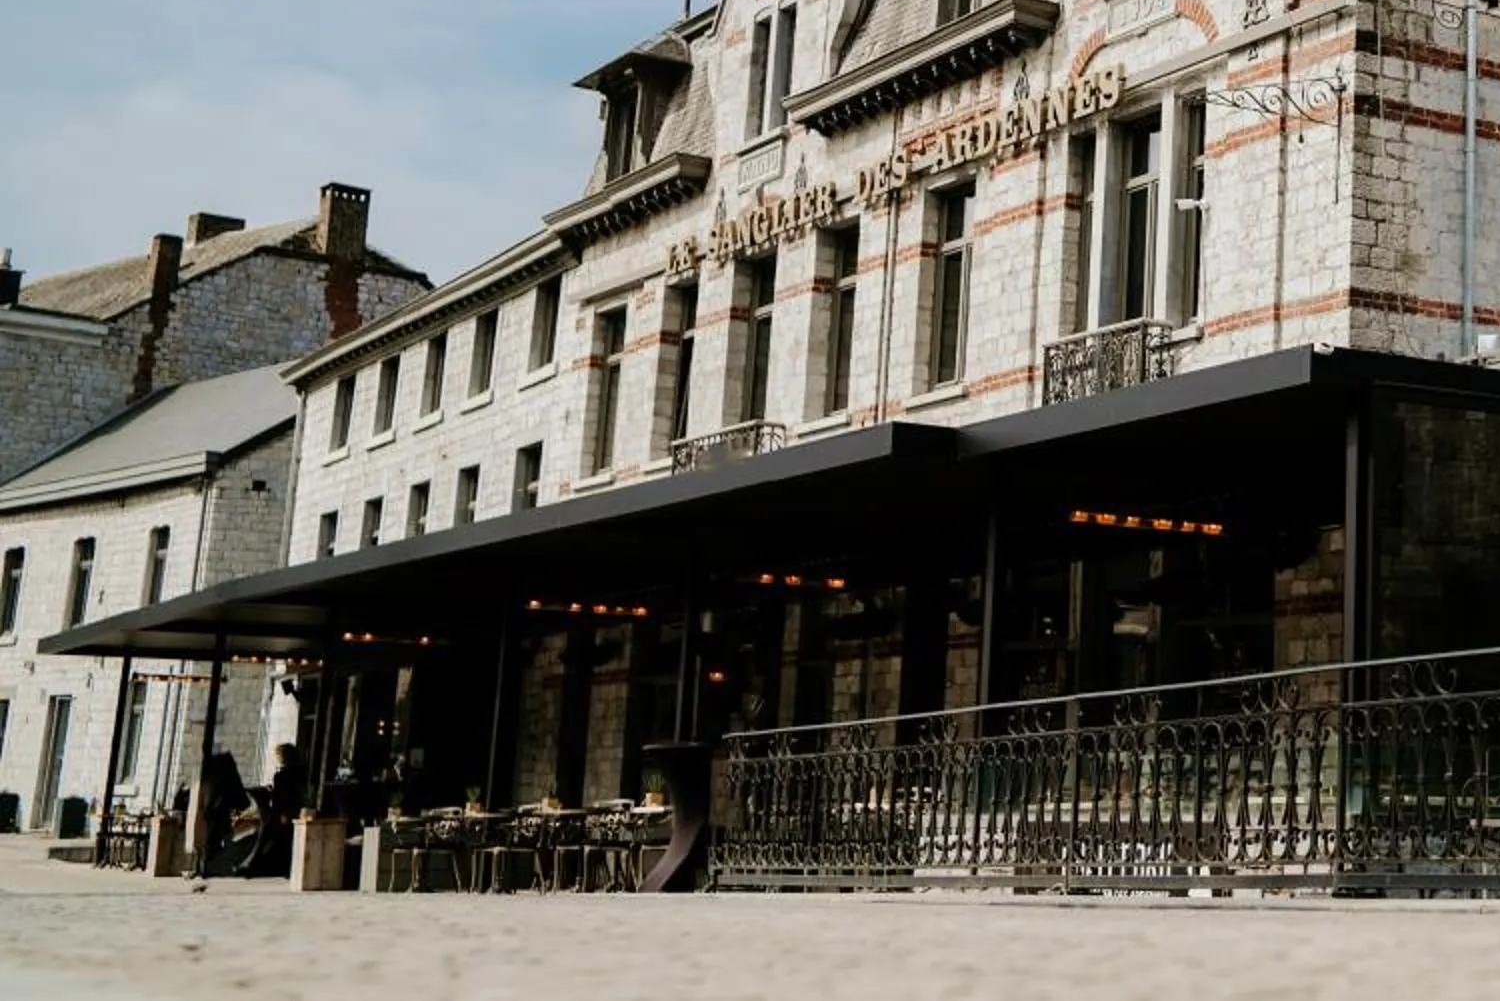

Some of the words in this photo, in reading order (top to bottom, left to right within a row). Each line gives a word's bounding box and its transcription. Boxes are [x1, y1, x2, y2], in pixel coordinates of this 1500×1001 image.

[665, 234, 698, 274] LE
[707, 180, 838, 259] SANGLIER
[855, 147, 911, 205] DES
[929, 62, 1126, 174] ARDENNES
